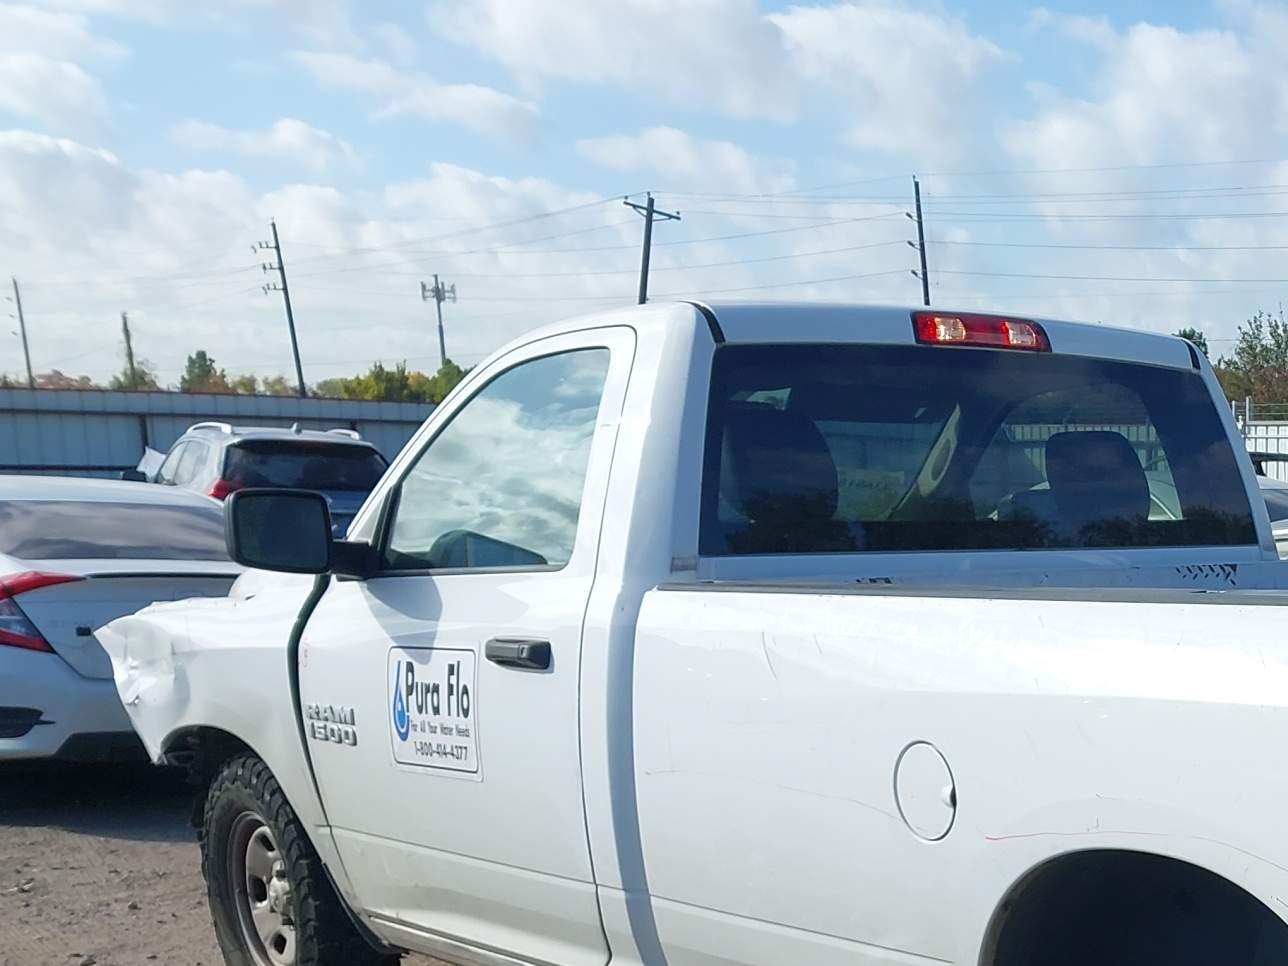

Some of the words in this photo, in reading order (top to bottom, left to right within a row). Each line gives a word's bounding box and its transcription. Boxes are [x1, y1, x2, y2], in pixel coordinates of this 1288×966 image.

[405, 660, 441, 716] Pura
[447, 660, 470, 719] Flo
[306, 703, 356, 726] RAM
[310, 721, 358, 747] 1500
